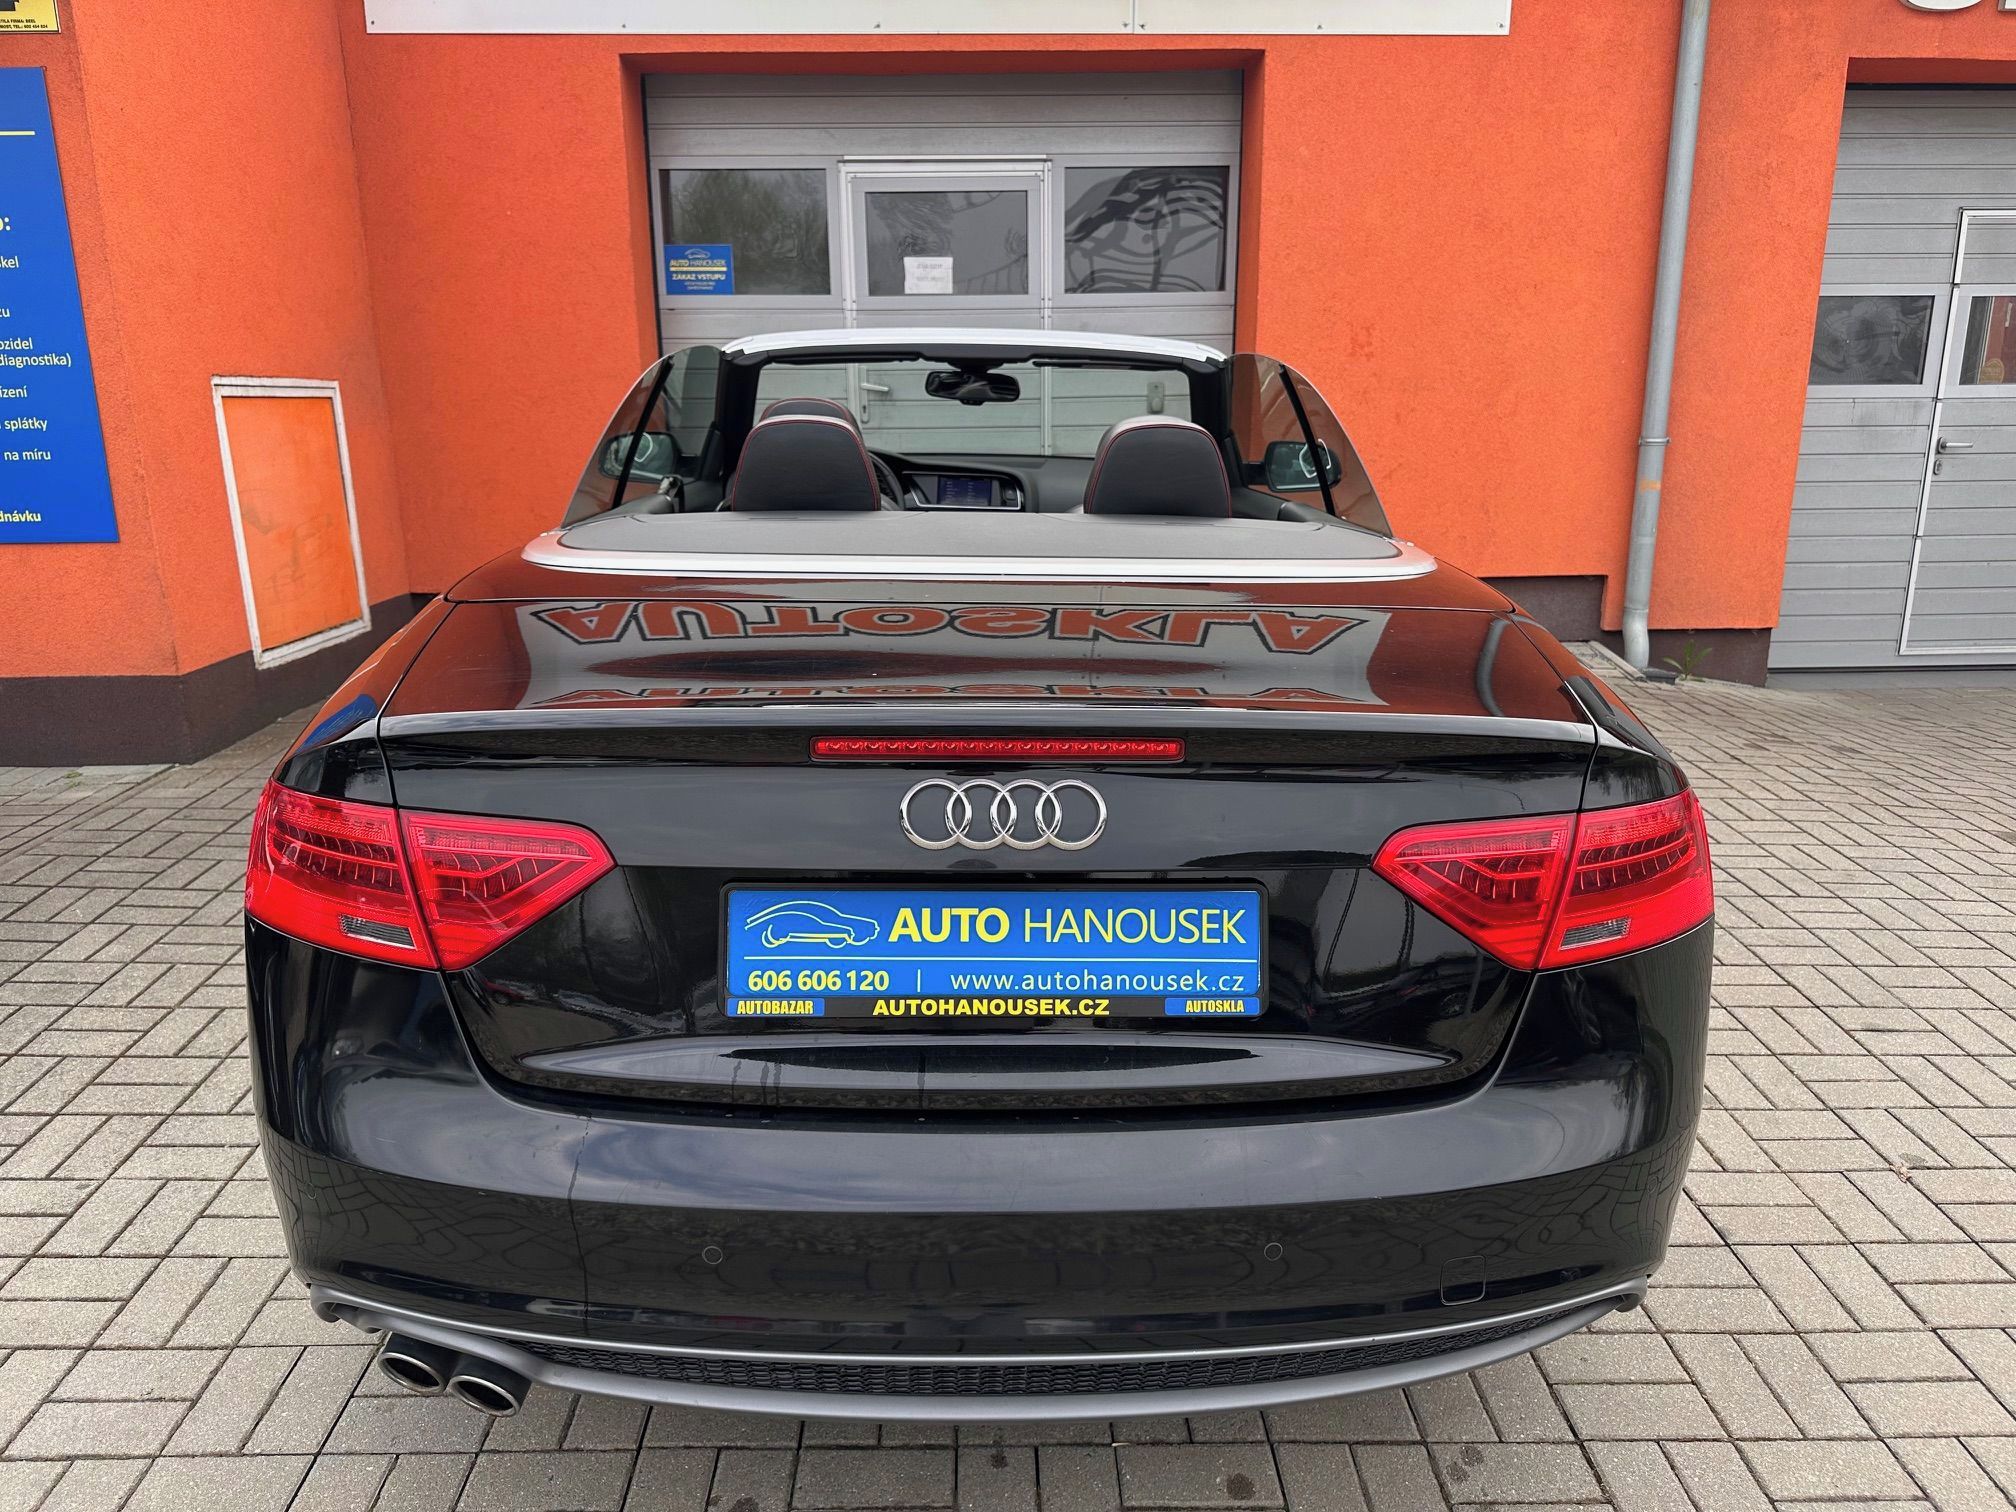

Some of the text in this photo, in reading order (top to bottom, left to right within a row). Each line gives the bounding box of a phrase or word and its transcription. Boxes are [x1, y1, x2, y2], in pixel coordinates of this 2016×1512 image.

[0, 256, 19, 268] kel
[4, 417, 48, 431] splátky
[4, 448, 51, 461] na míru
[888, 907, 1247, 944] AUTO HANOUSEK
[748, 968, 1245, 992] 606 606 120 www.autohanousek.cz
[737, 999, 1245, 1016] AUTOBAZAR AUTOHANOUSEK.CZ AUTOSKLA
